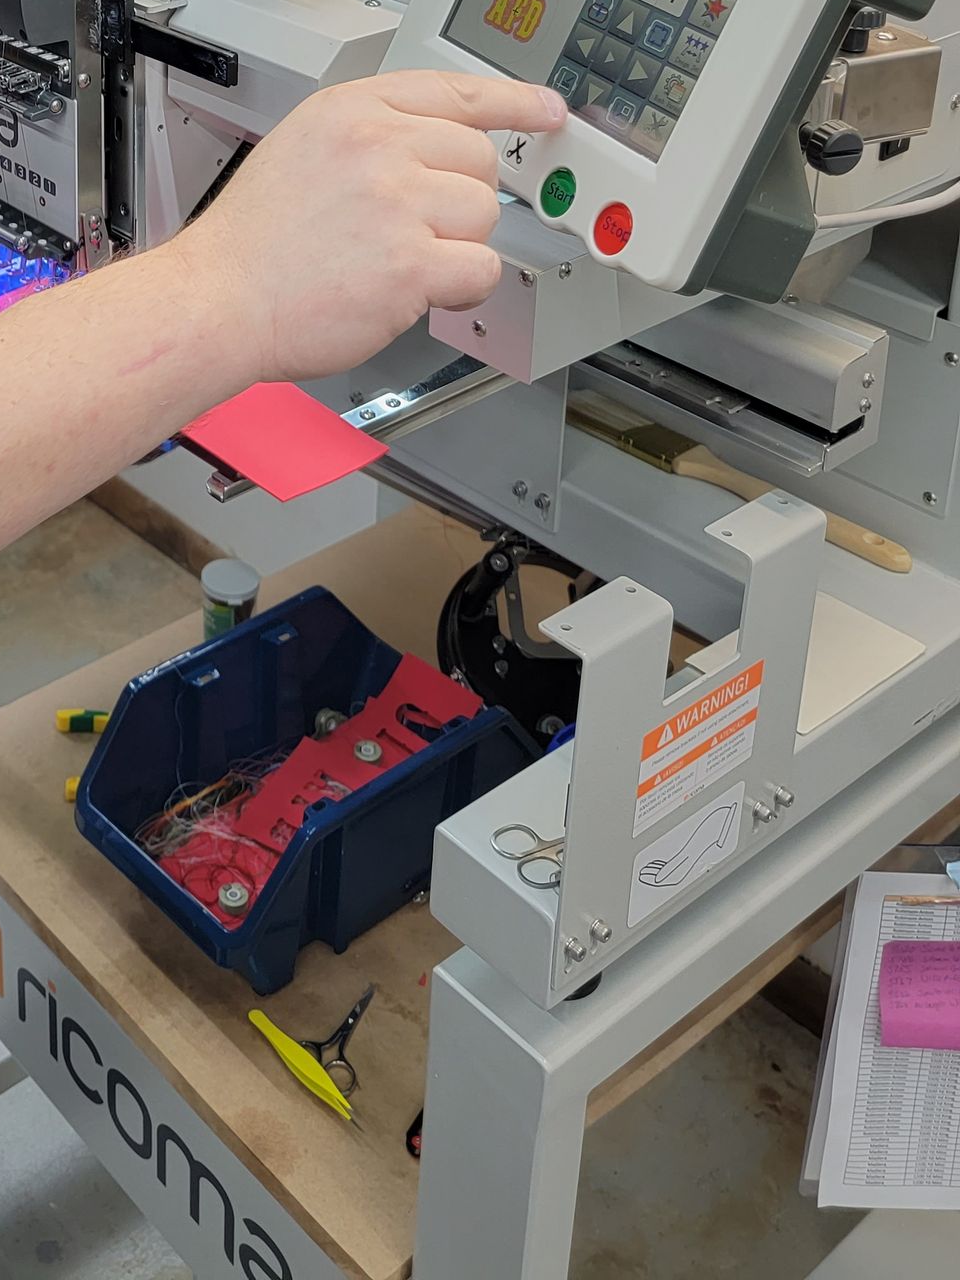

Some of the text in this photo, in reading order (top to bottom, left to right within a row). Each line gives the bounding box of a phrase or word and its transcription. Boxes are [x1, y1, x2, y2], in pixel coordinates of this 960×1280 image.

[546, 182, 575, 206] Start
[602, 216, 632, 243] Stop
[676, 673, 750, 734] WARNING!
[17, 967, 294, 1280] ricoma
